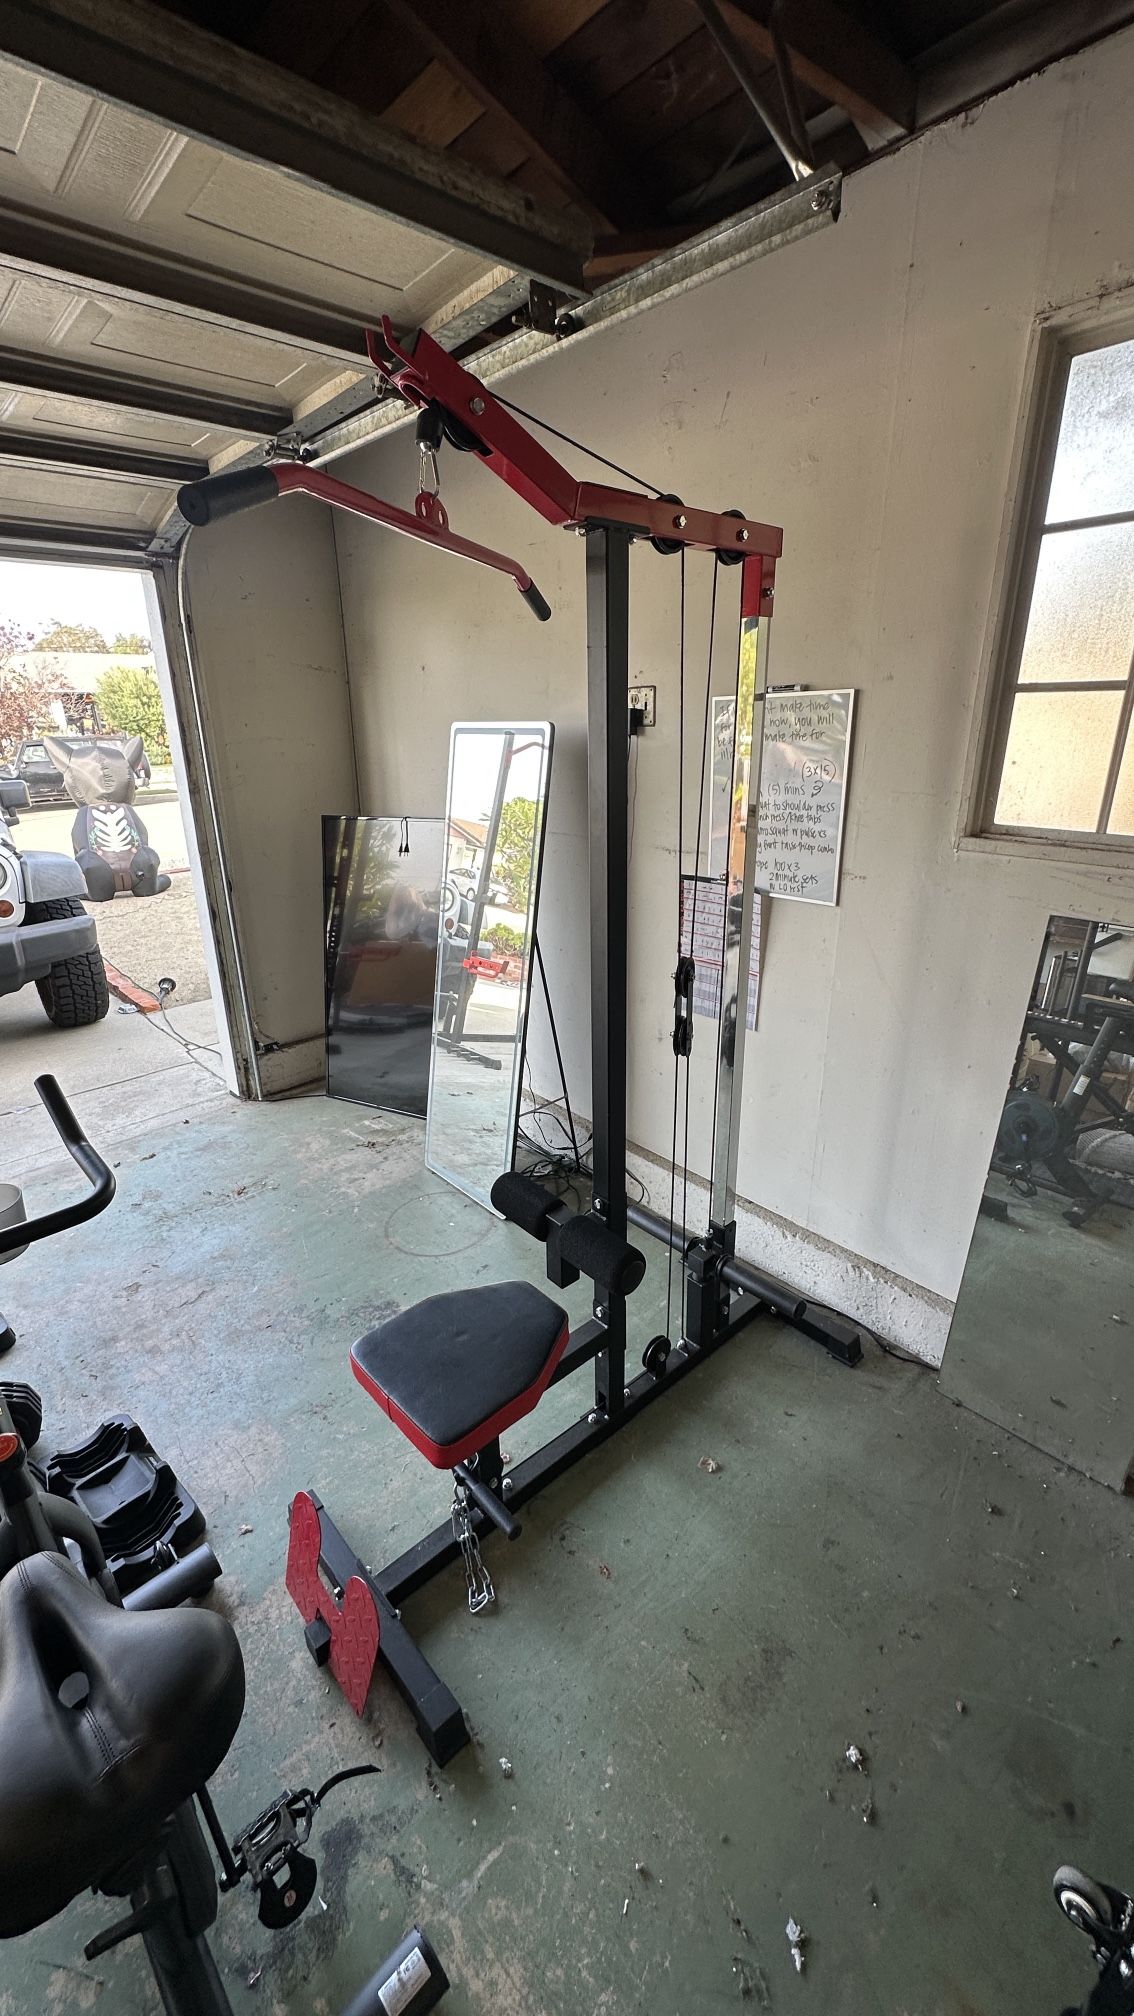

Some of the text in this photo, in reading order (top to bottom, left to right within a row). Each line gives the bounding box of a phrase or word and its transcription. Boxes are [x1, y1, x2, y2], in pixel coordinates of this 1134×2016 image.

[806, 699, 829, 713] time
[794, 716, 812, 734] you
[817, 712, 834, 726] will
[768, 781, 781, 797] (5)
[784, 782, 806, 796] mins
